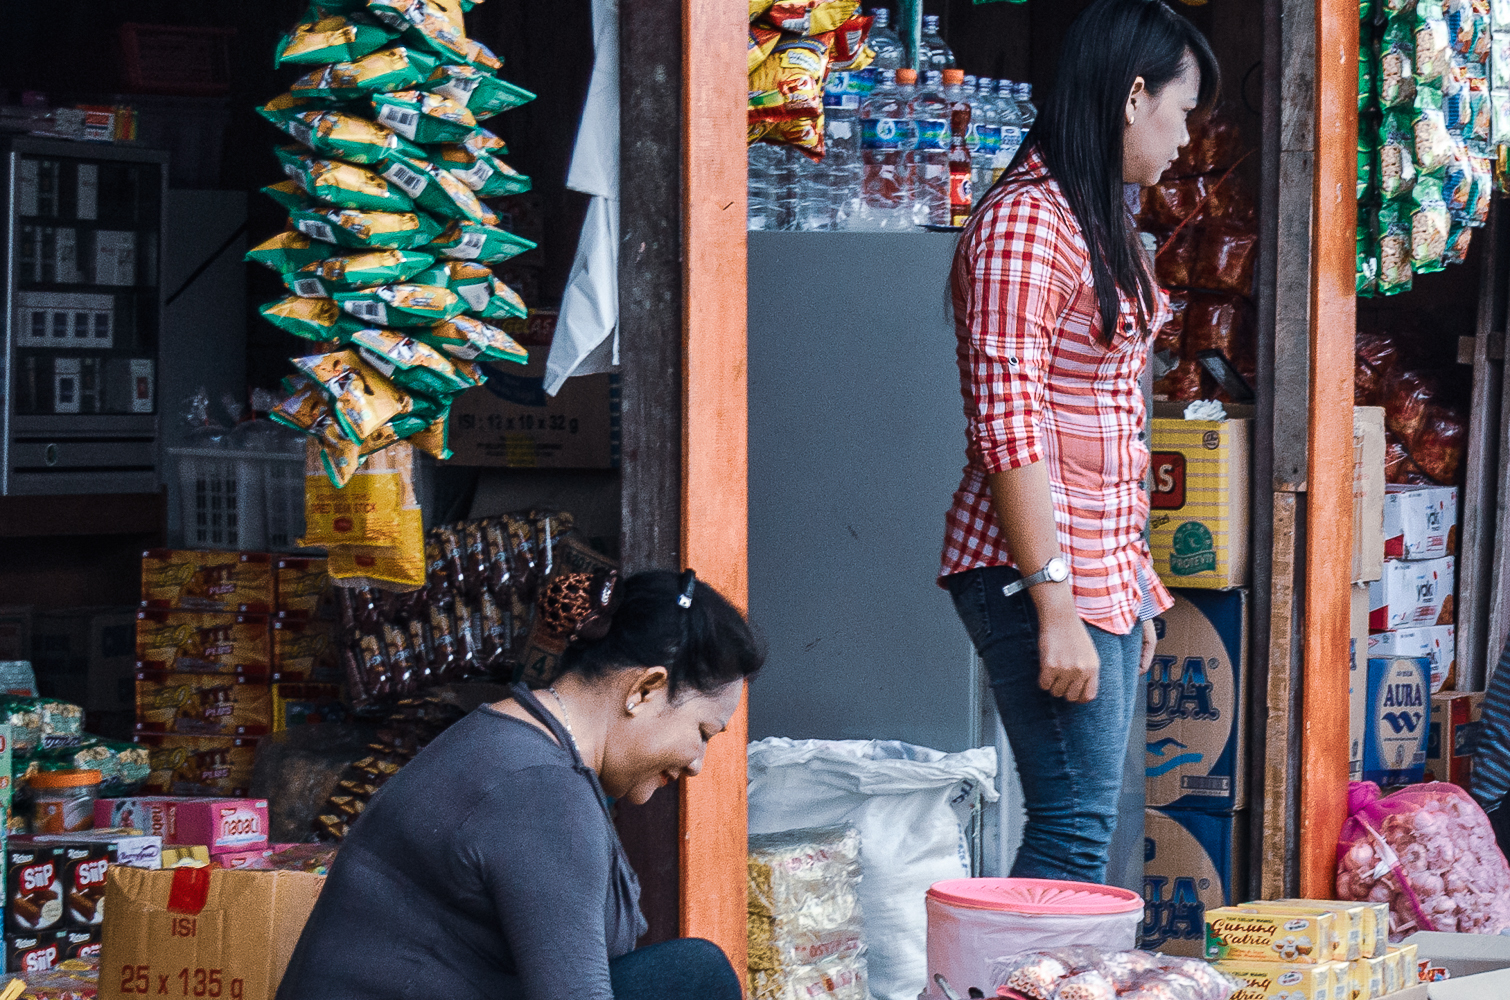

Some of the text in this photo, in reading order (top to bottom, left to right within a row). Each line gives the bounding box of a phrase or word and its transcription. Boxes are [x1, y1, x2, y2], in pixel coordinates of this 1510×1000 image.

[1383, 683, 1423, 707] AURA
[171, 918, 197, 937] ISI
[1210, 918, 1278, 938] Gunung
[120, 964, 150, 994] 25
[157, 974, 170, 995] x
[178, 967, 223, 998] 135
